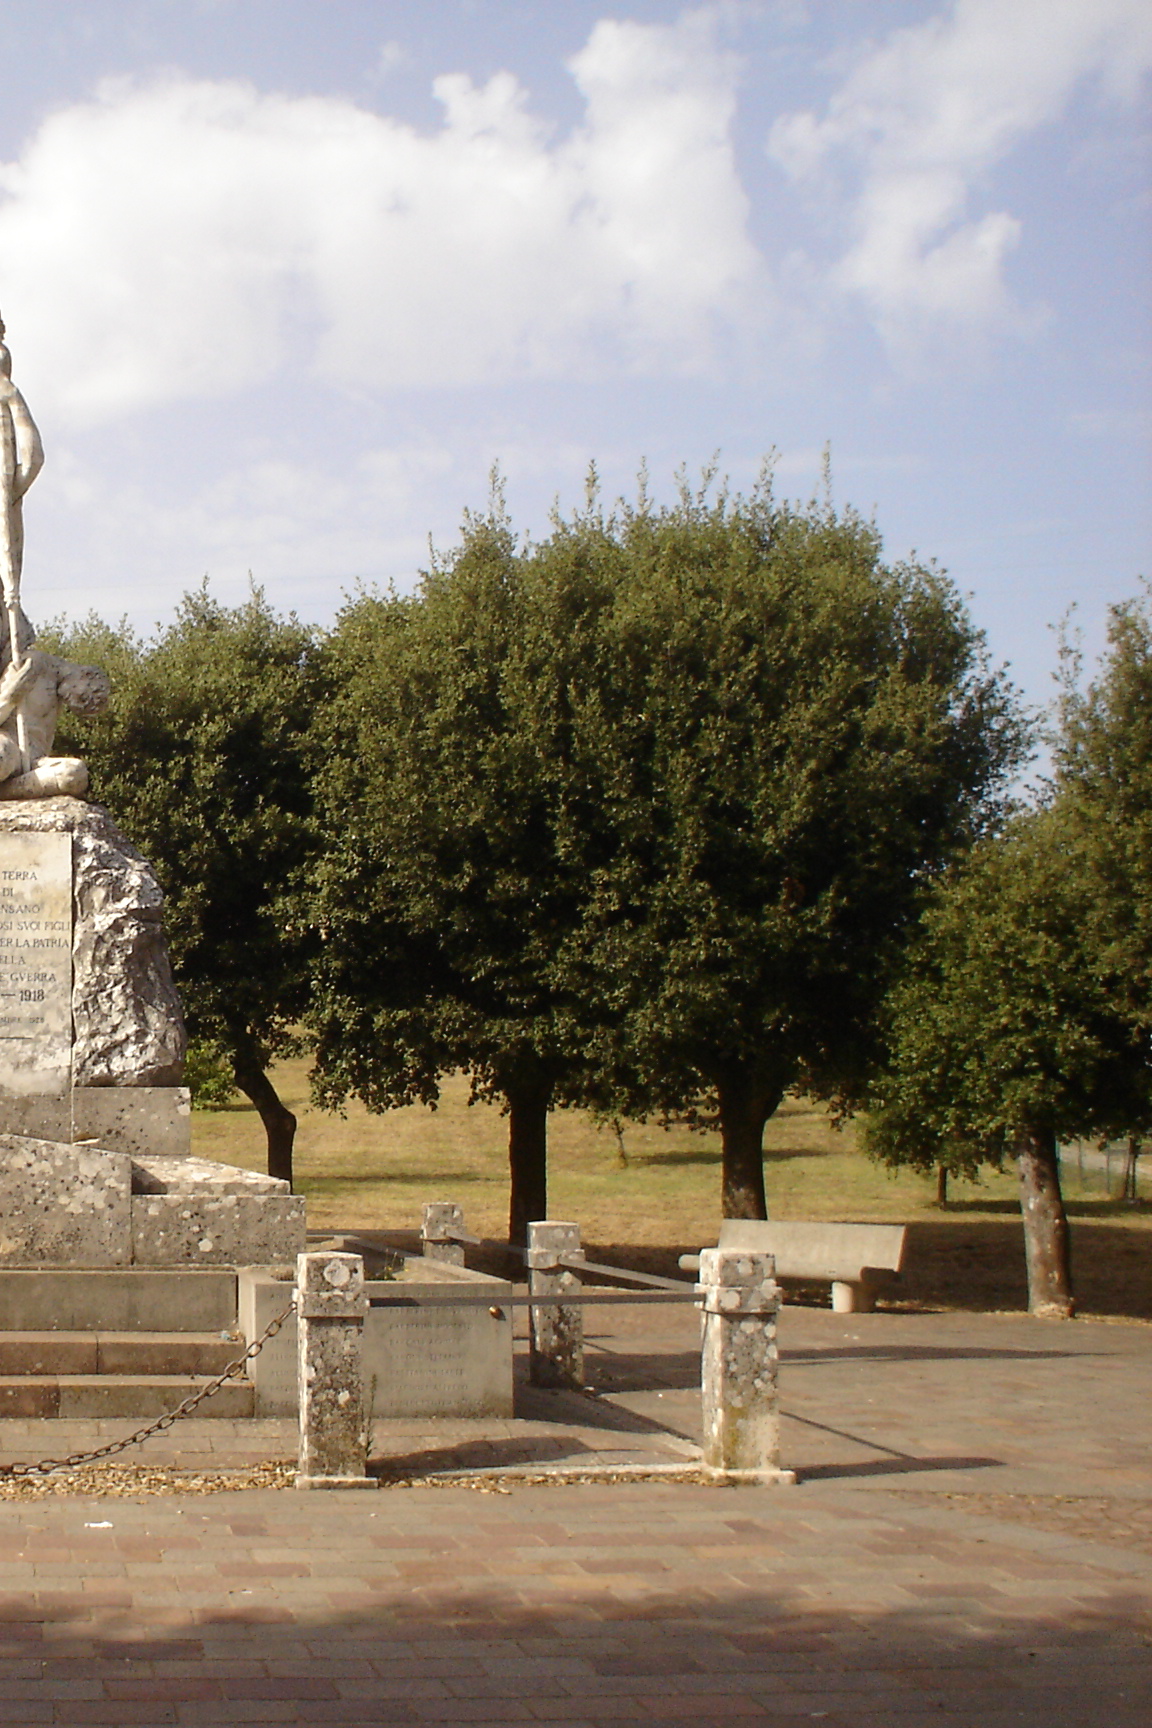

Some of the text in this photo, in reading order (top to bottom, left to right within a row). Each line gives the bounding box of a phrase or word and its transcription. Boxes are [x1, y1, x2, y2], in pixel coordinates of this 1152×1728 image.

[1, 870, 38, 881] TERRA
[2, 887, 14, 897] DI
[17, 921, 40, 931] SVOI
[44, 921, 70, 932] FIGLI
[15, 938, 30, 948] LA
[32, 938, 69, 949] PATRIA
[9, 972, 57, 982] GVERRA
[19, 988, 45, 1002] 1918
